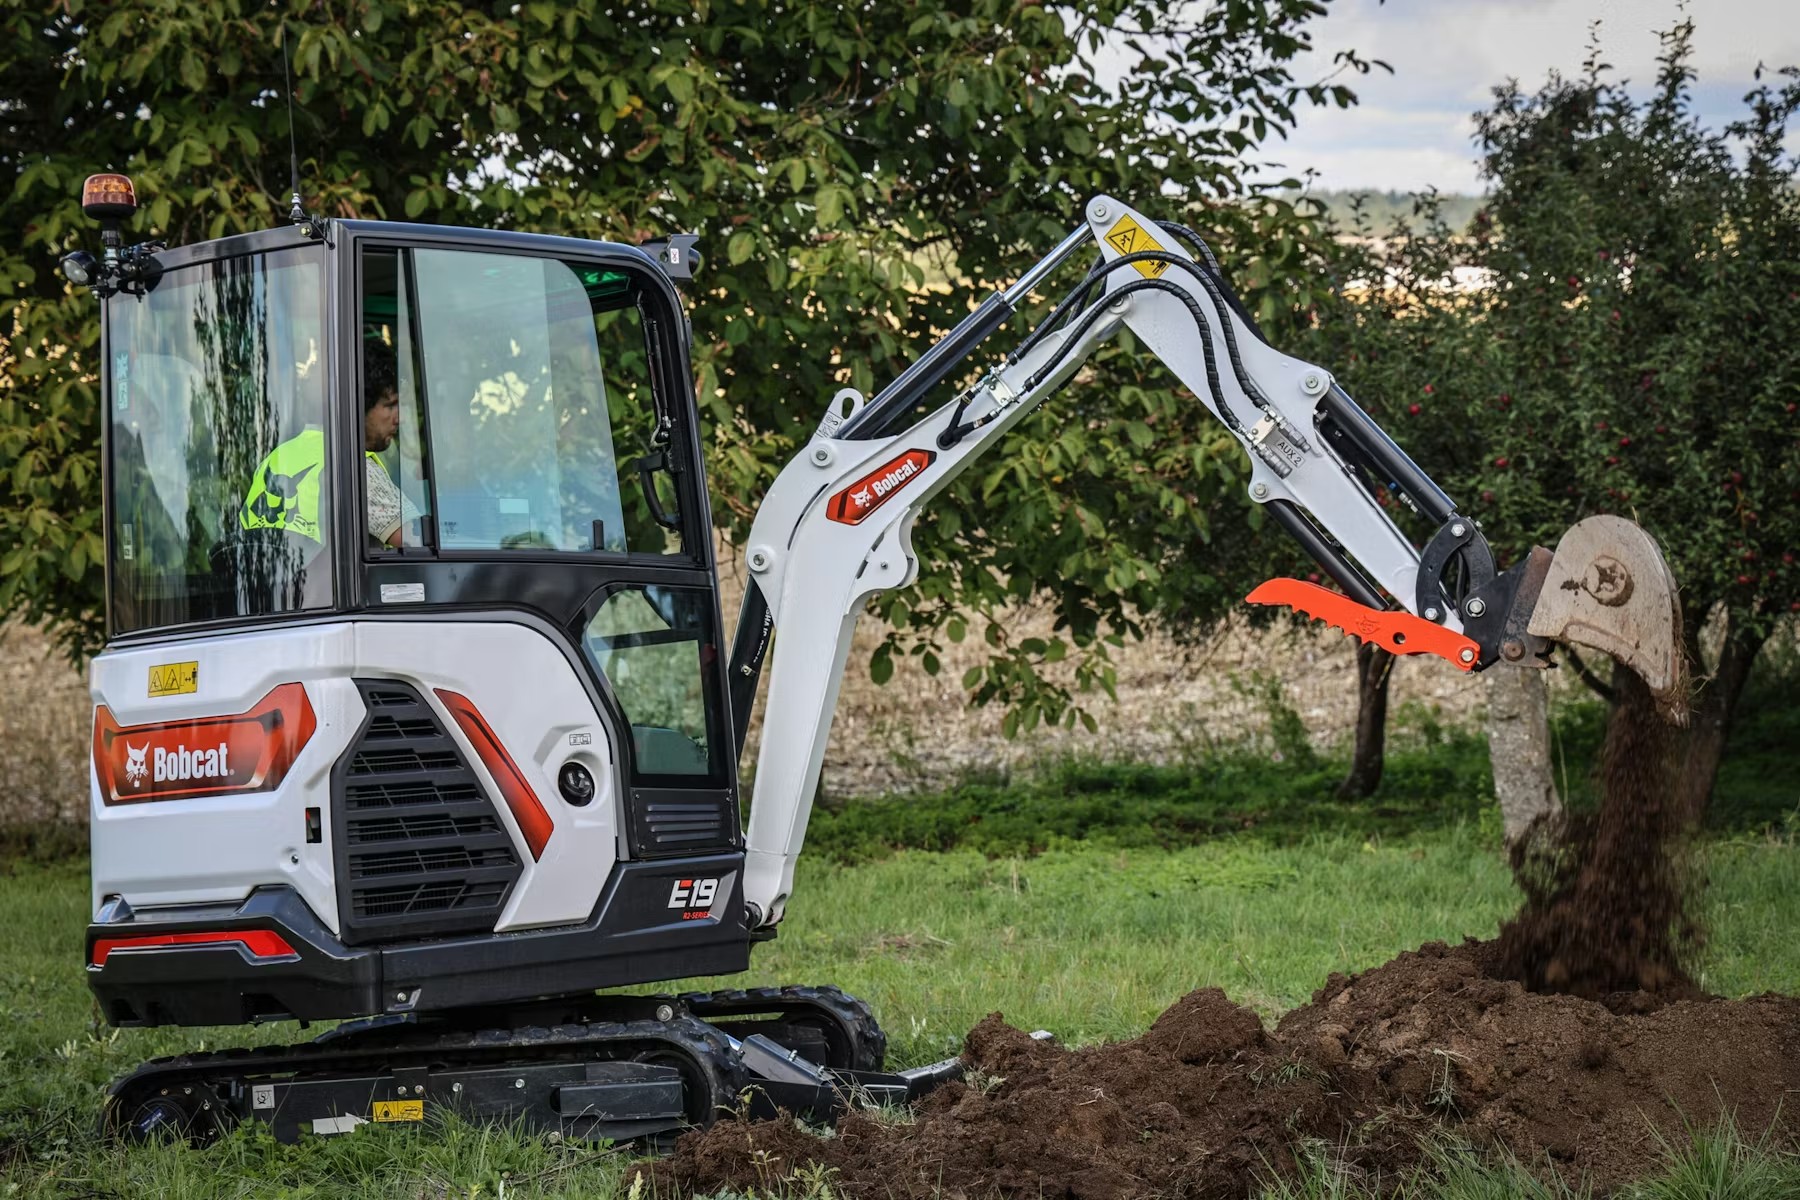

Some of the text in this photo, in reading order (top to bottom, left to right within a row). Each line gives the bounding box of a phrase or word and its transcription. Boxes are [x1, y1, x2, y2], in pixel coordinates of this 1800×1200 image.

[1277, 441, 1302, 465] AUX 2
[871, 458, 918, 497] Bobcat
[153, 742, 229, 783] Bobcat
[667, 878, 718, 909] E19
